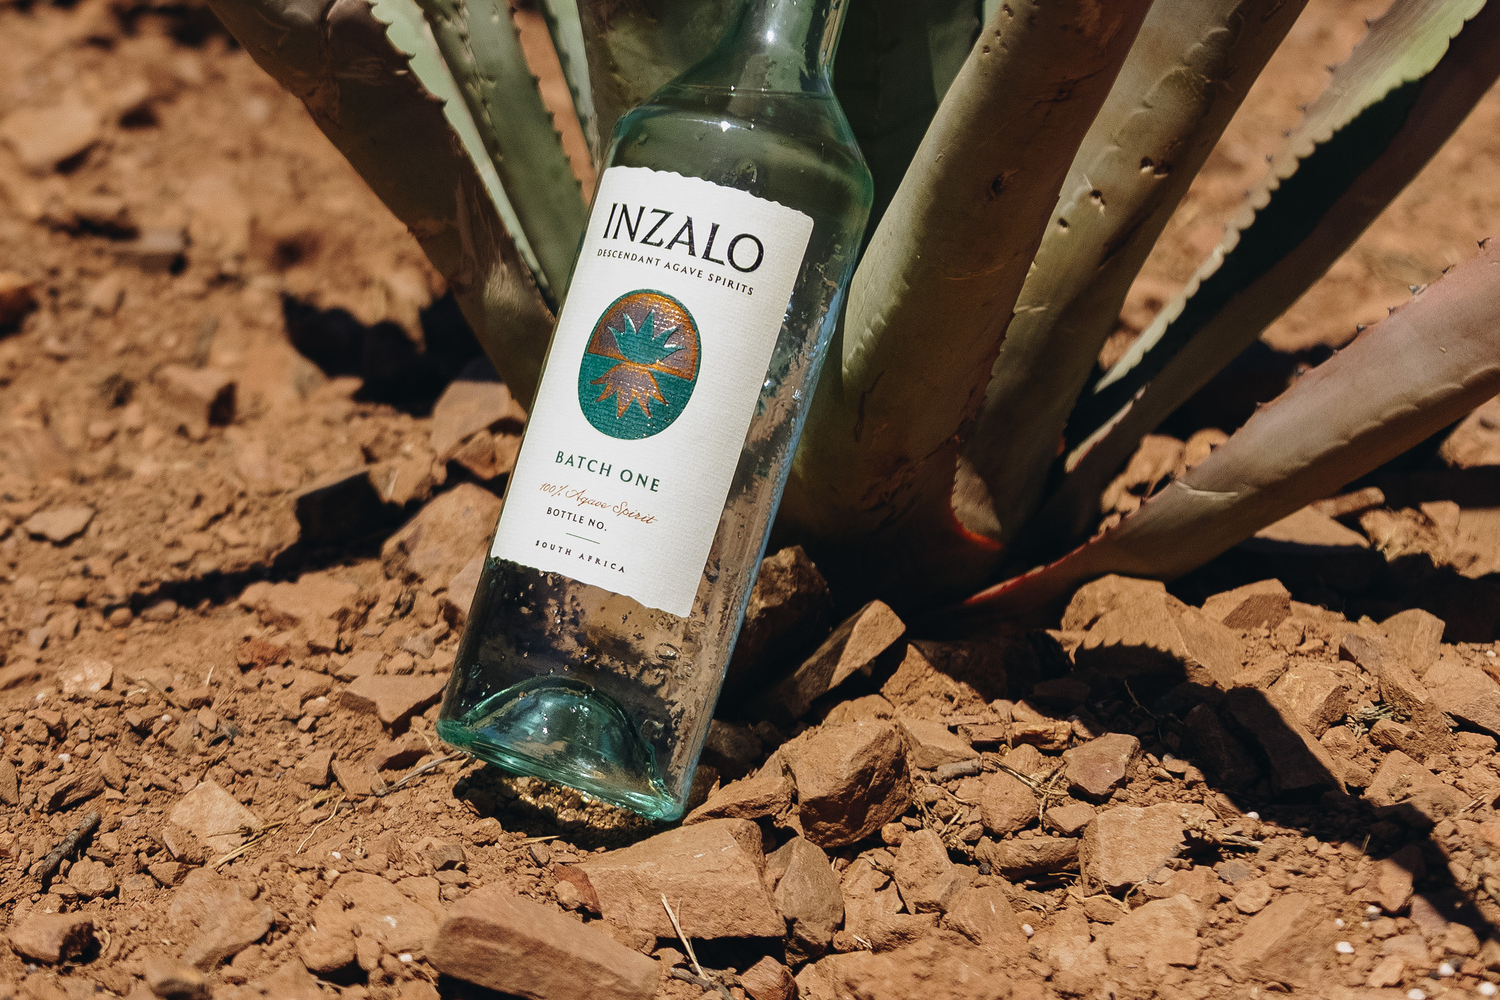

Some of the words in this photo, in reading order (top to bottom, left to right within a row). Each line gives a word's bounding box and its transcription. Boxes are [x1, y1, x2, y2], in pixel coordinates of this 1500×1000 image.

[602, 202, 765, 273] INZALO
[597, 248, 662, 267] DESCENDANT
[664, 261, 704, 279] AGAVE
[707, 273, 754, 296] SPIRITS
[554, 450, 613, 477] BATCH
[619, 469, 661, 493] ONE
[539, 482, 569, 498] 100%
[565, 488, 611, 509] Agave
[612, 501, 659, 525] Spirit
[546, 507, 584, 524] BOTTLE
[587, 518, 607, 532] NO.
[535, 539, 572, 556] SOUTH
[578, 552, 625, 574] AFRICA
